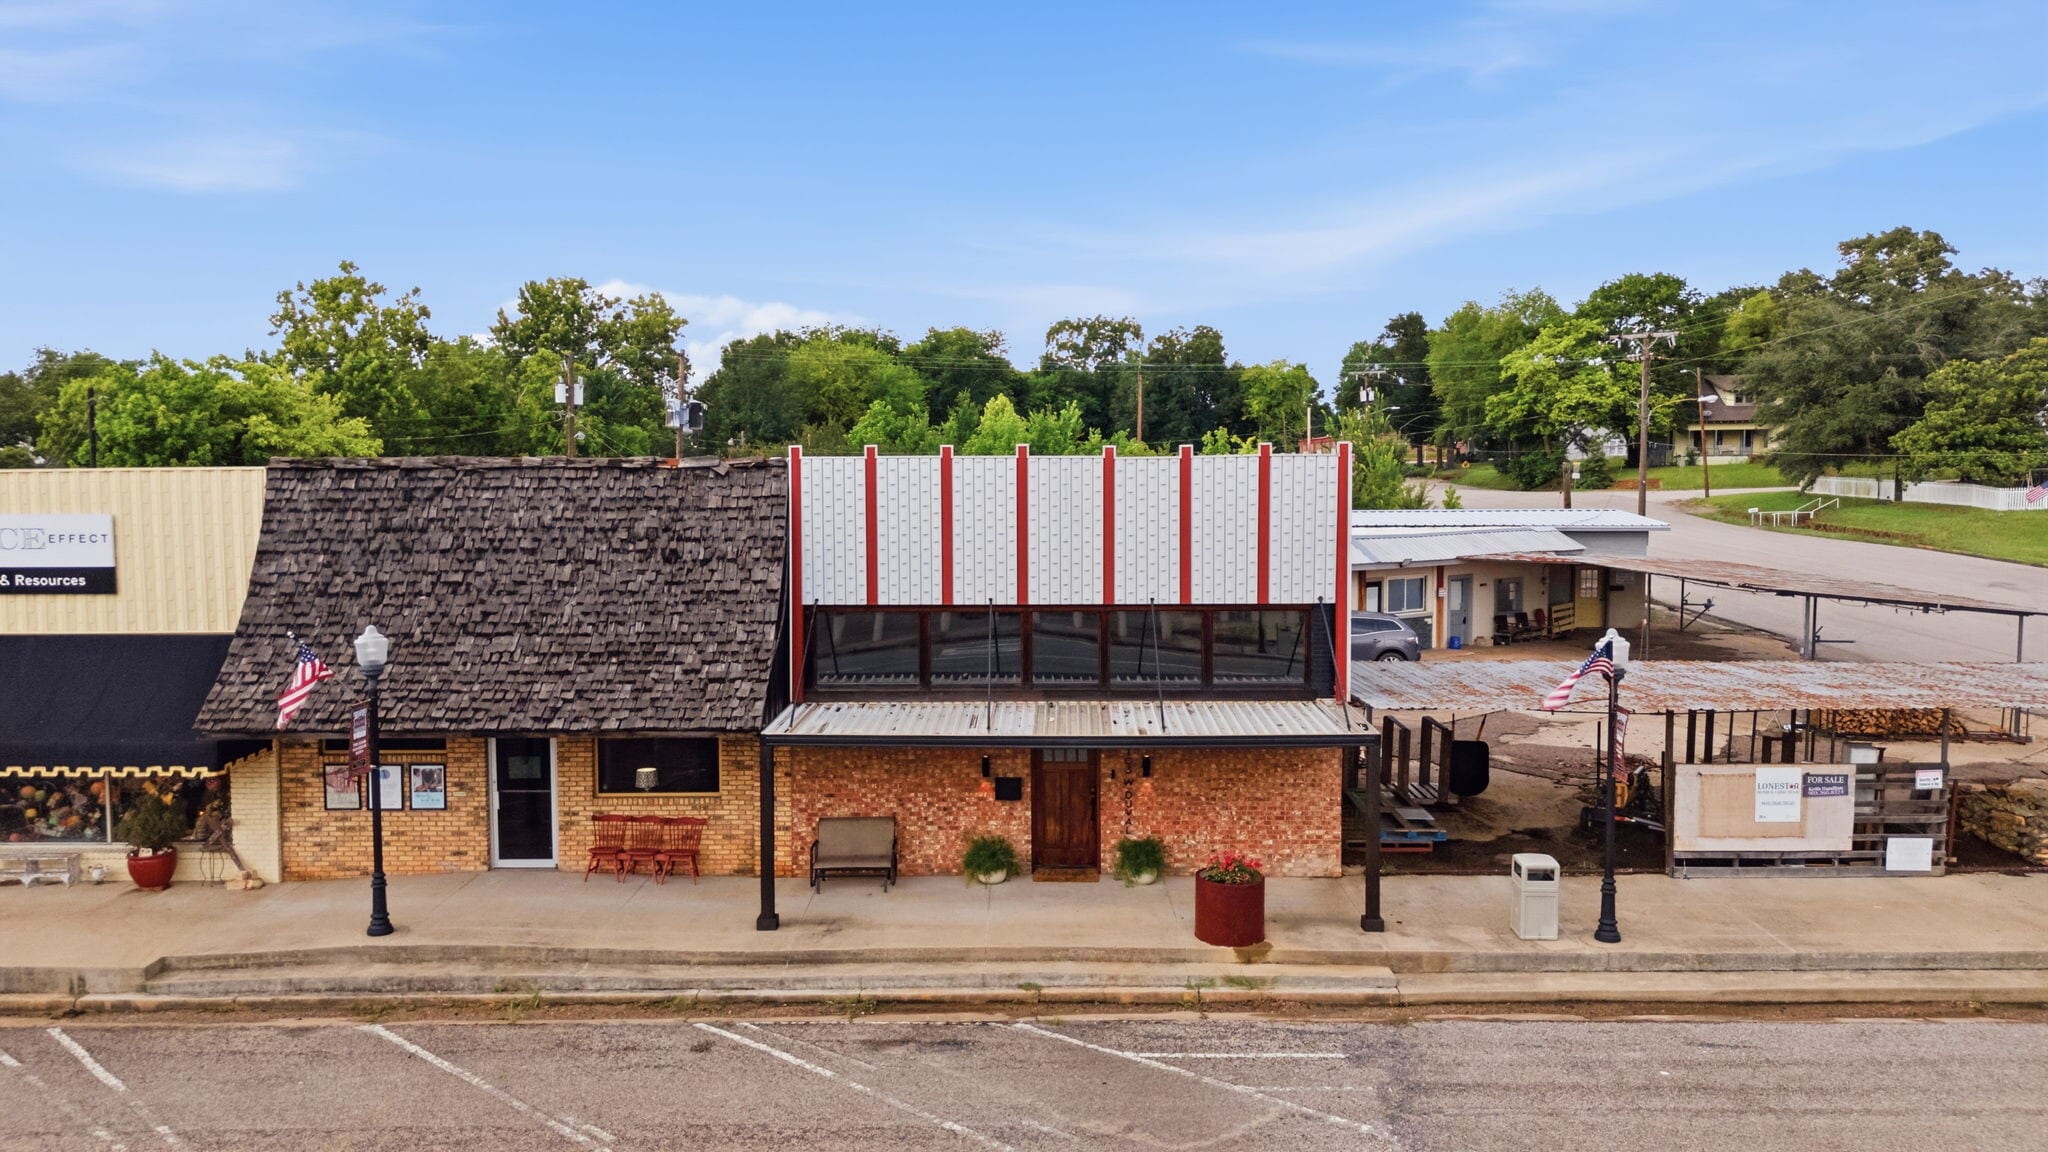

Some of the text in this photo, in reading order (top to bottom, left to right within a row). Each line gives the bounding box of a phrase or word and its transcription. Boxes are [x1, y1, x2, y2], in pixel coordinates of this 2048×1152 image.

[48, 533, 108, 544] EFFECT
[0, 574, 87, 586] & Resources
[1807, 775, 1845, 784] FOR SALE
[1125, 790, 1133, 834] DUVAL
